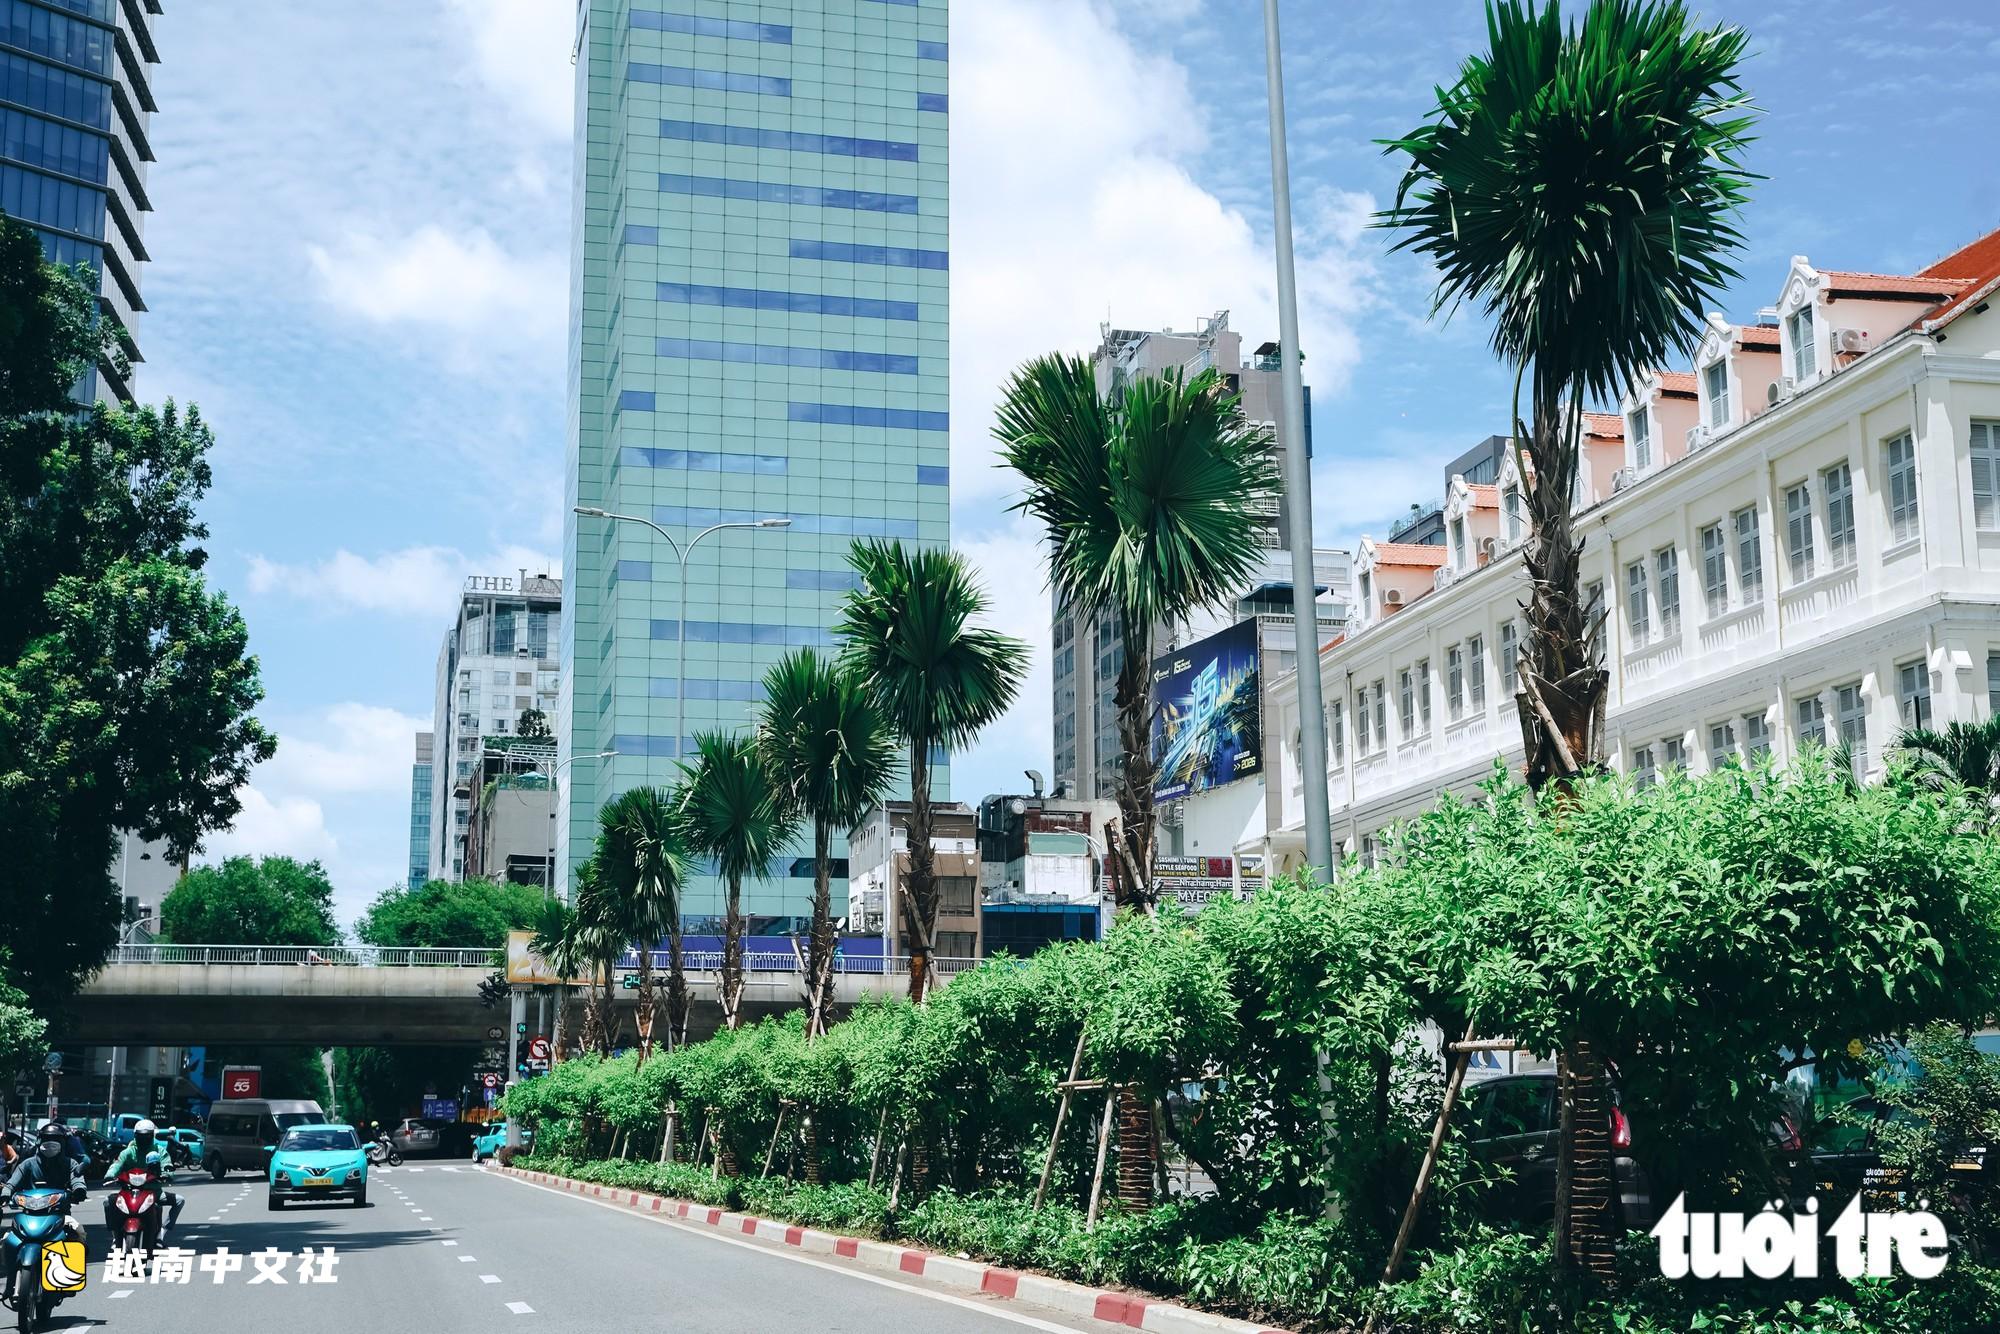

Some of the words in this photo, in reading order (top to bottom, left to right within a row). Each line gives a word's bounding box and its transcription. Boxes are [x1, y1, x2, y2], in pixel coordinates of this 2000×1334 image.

[468, 575, 514, 591] THE
[1175, 864, 1198, 872] SEAFOOD
[233, 1081, 251, 1093] 5G
